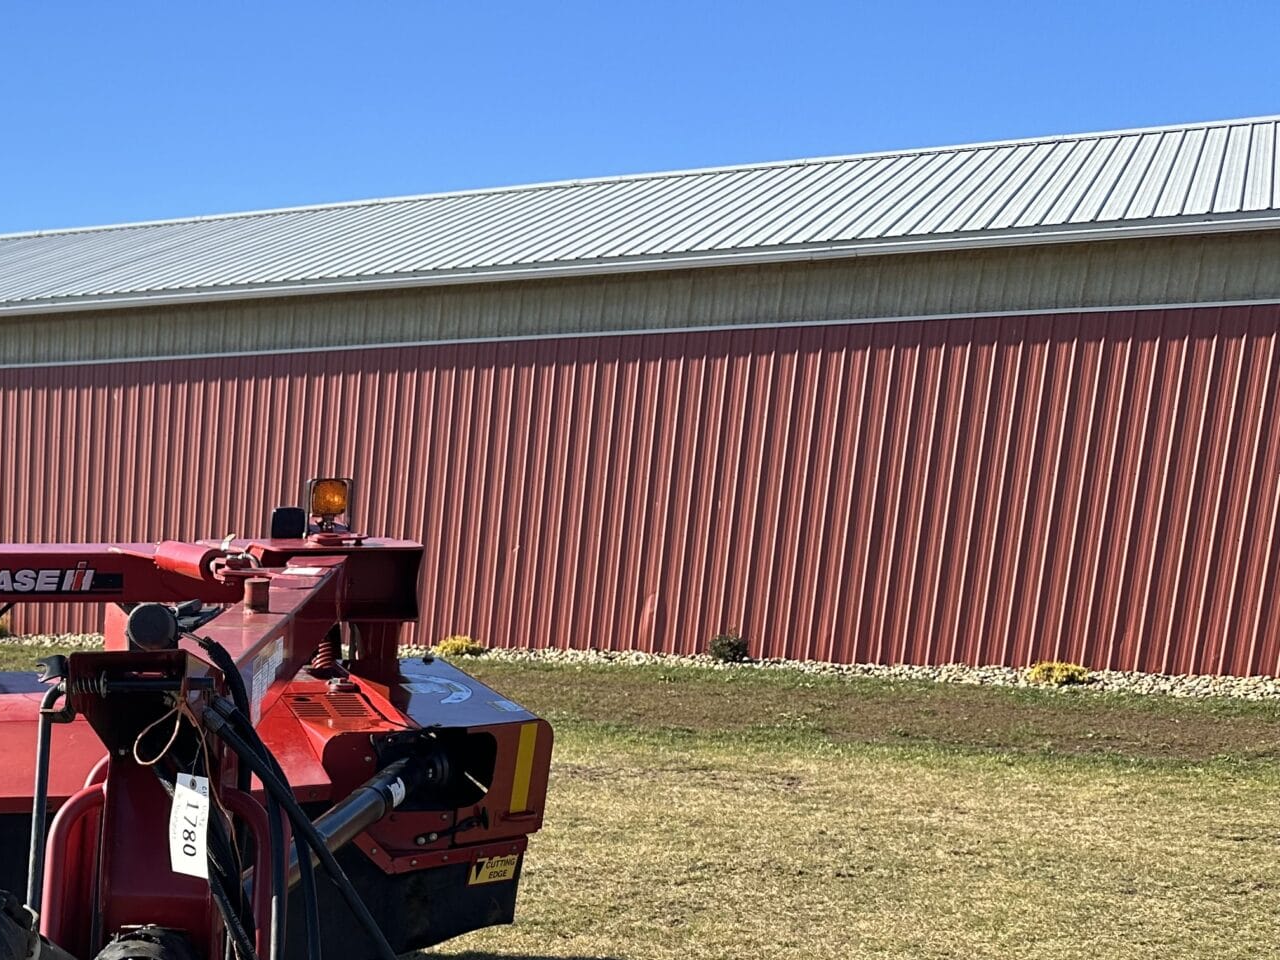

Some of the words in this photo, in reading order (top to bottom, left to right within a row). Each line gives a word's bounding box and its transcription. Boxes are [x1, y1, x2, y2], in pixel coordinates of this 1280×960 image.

[182, 800, 199, 857] 1780
[486, 857, 515, 869] CUTTING
[488, 869, 507, 878] EDGE
